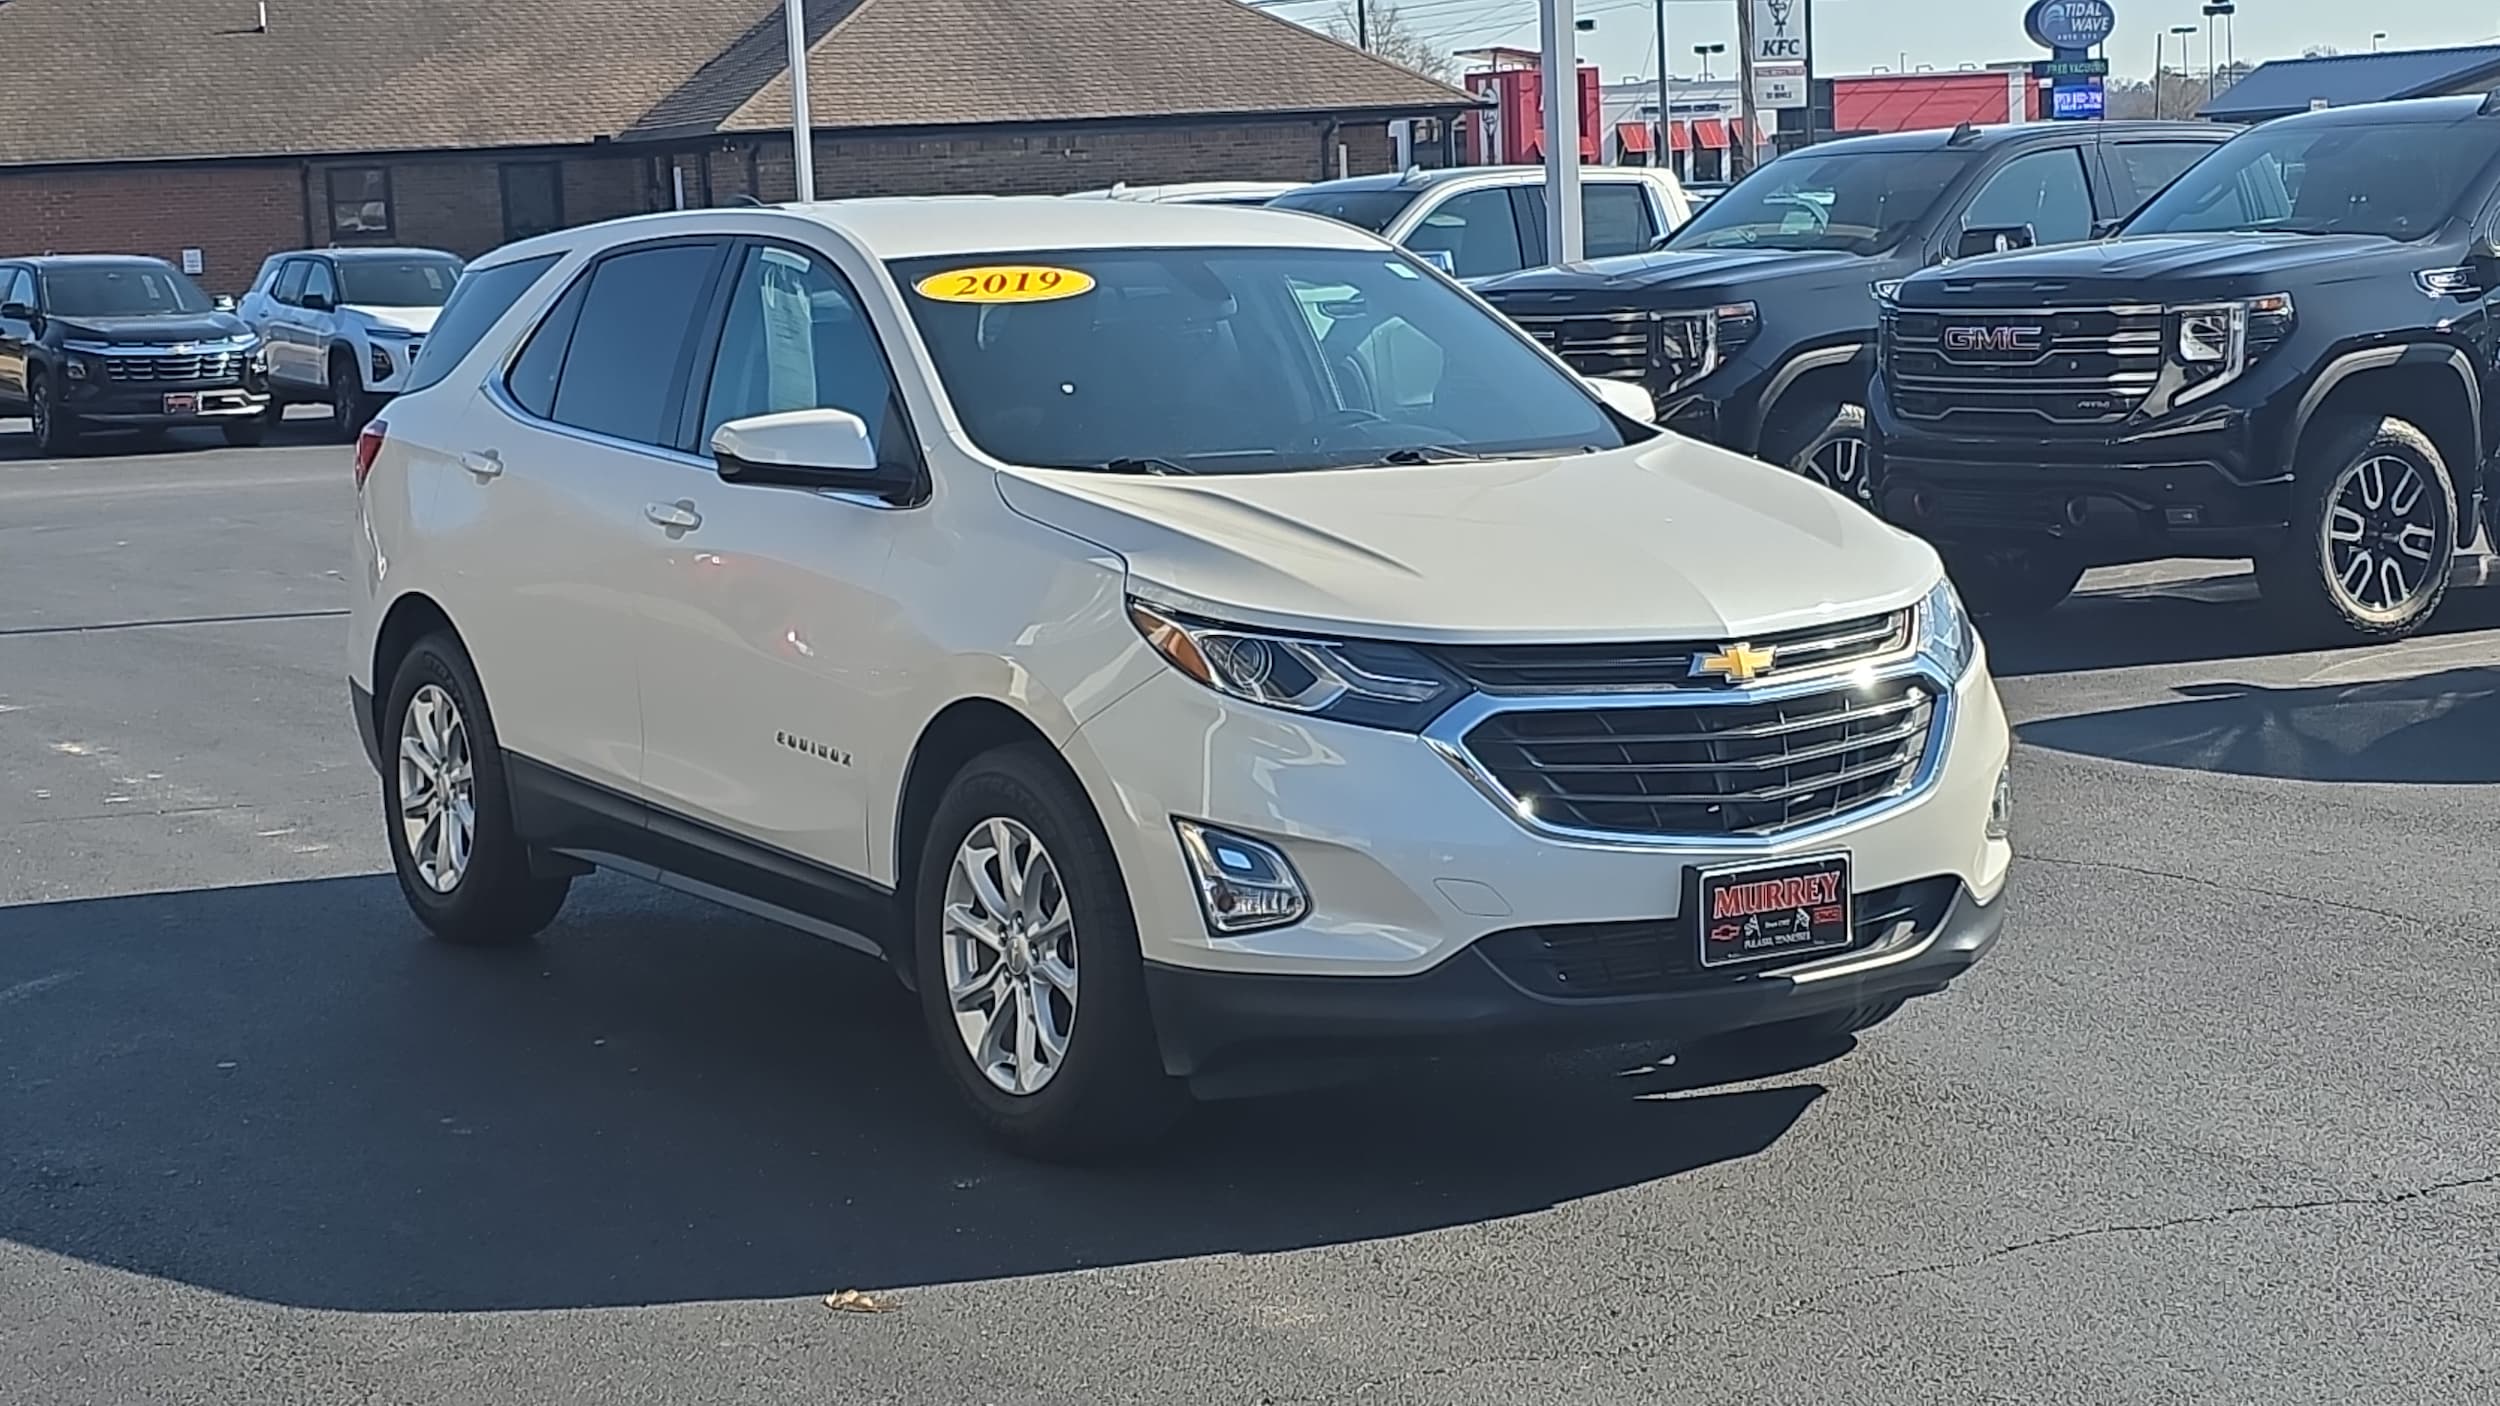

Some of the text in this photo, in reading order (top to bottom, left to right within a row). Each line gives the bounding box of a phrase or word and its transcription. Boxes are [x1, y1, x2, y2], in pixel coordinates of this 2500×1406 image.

[2065, 3, 2102, 17] TIDAL
[2071, 17, 2110, 32] WAVE
[1761, 38, 1801, 57] KFC
[954, 271, 1063, 296] 2019
[1944, 326, 2043, 351] GMC
[775, 730, 854, 768] EQUINOX
[1712, 870, 1841, 920] MURREY
